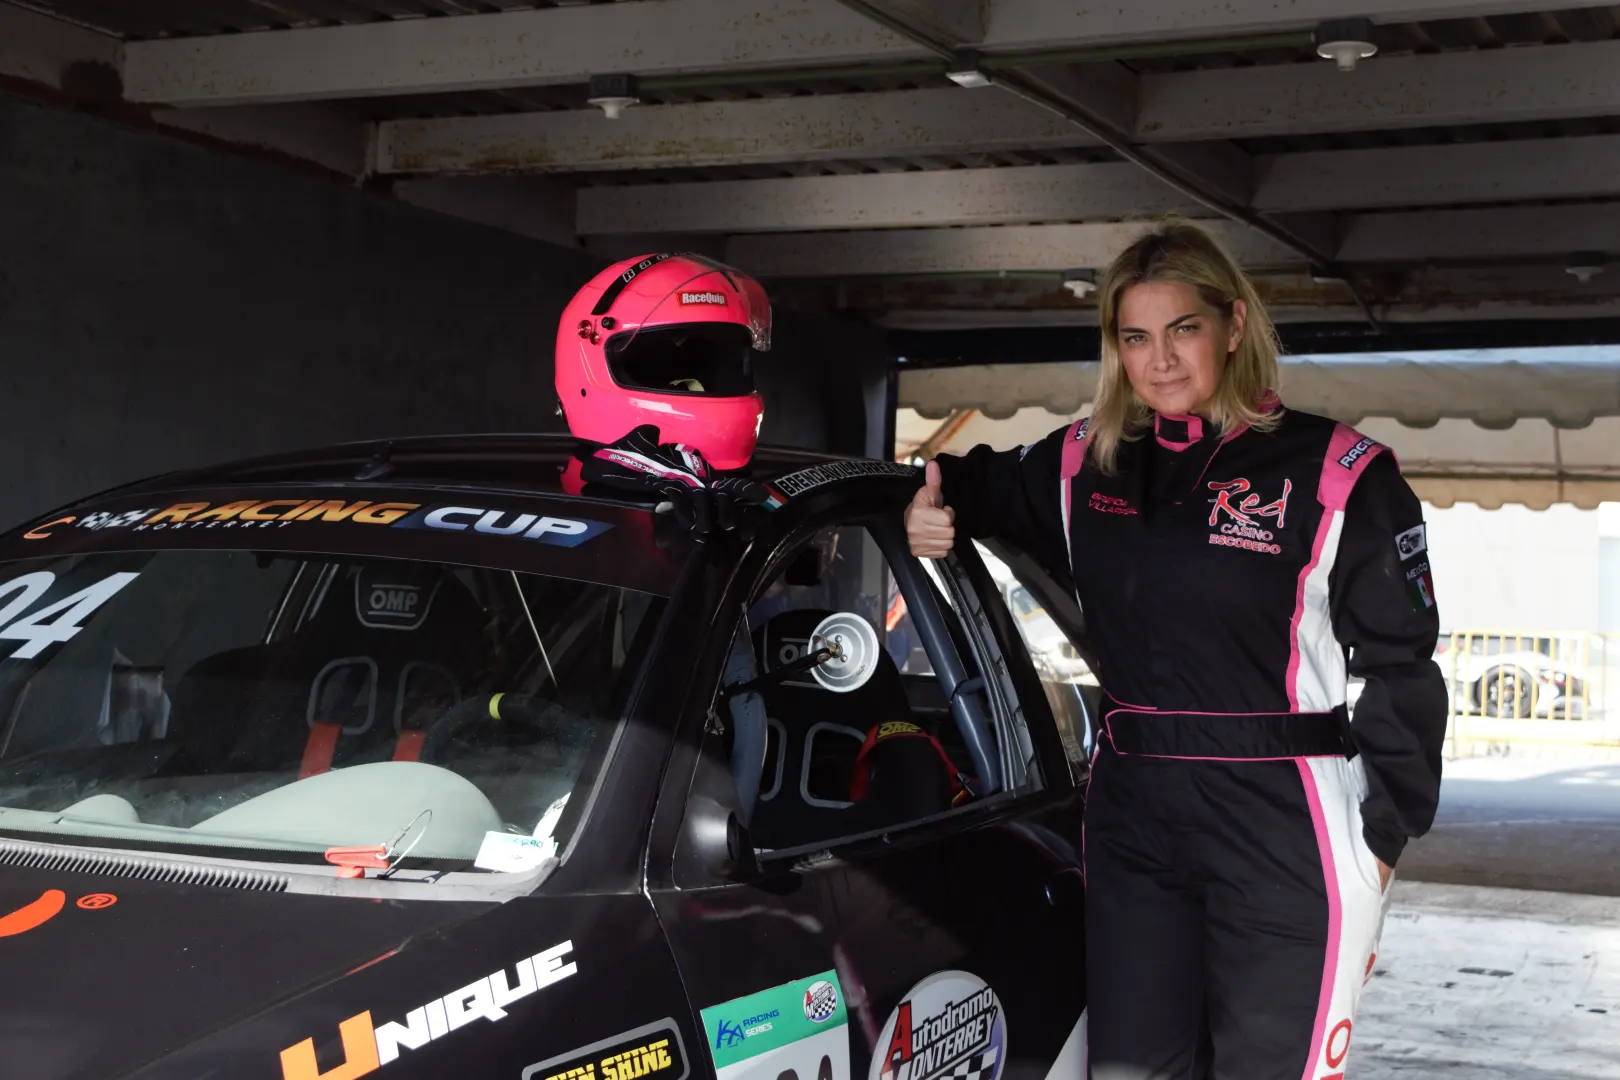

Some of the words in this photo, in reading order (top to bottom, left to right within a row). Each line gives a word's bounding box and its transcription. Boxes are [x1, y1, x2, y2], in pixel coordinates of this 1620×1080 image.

[682, 292, 725, 305] RaceQuip
[1208, 478, 1292, 528] Red
[144, 500, 422, 524] RACING
[424, 506, 588, 539] CUP
[1221, 523, 1274, 541] CASINO
[1209, 533, 1281, 554] ESCOBEDO
[370, 590, 419, 611] OMP
[280, 939, 577, 1080] UNIQUE
[743, 1009, 780, 1027] RACING
[745, 1022, 773, 1037] SERIES
[881, 987, 993, 1073] Autodromo
[601, 1039, 672, 1080] SHINE
